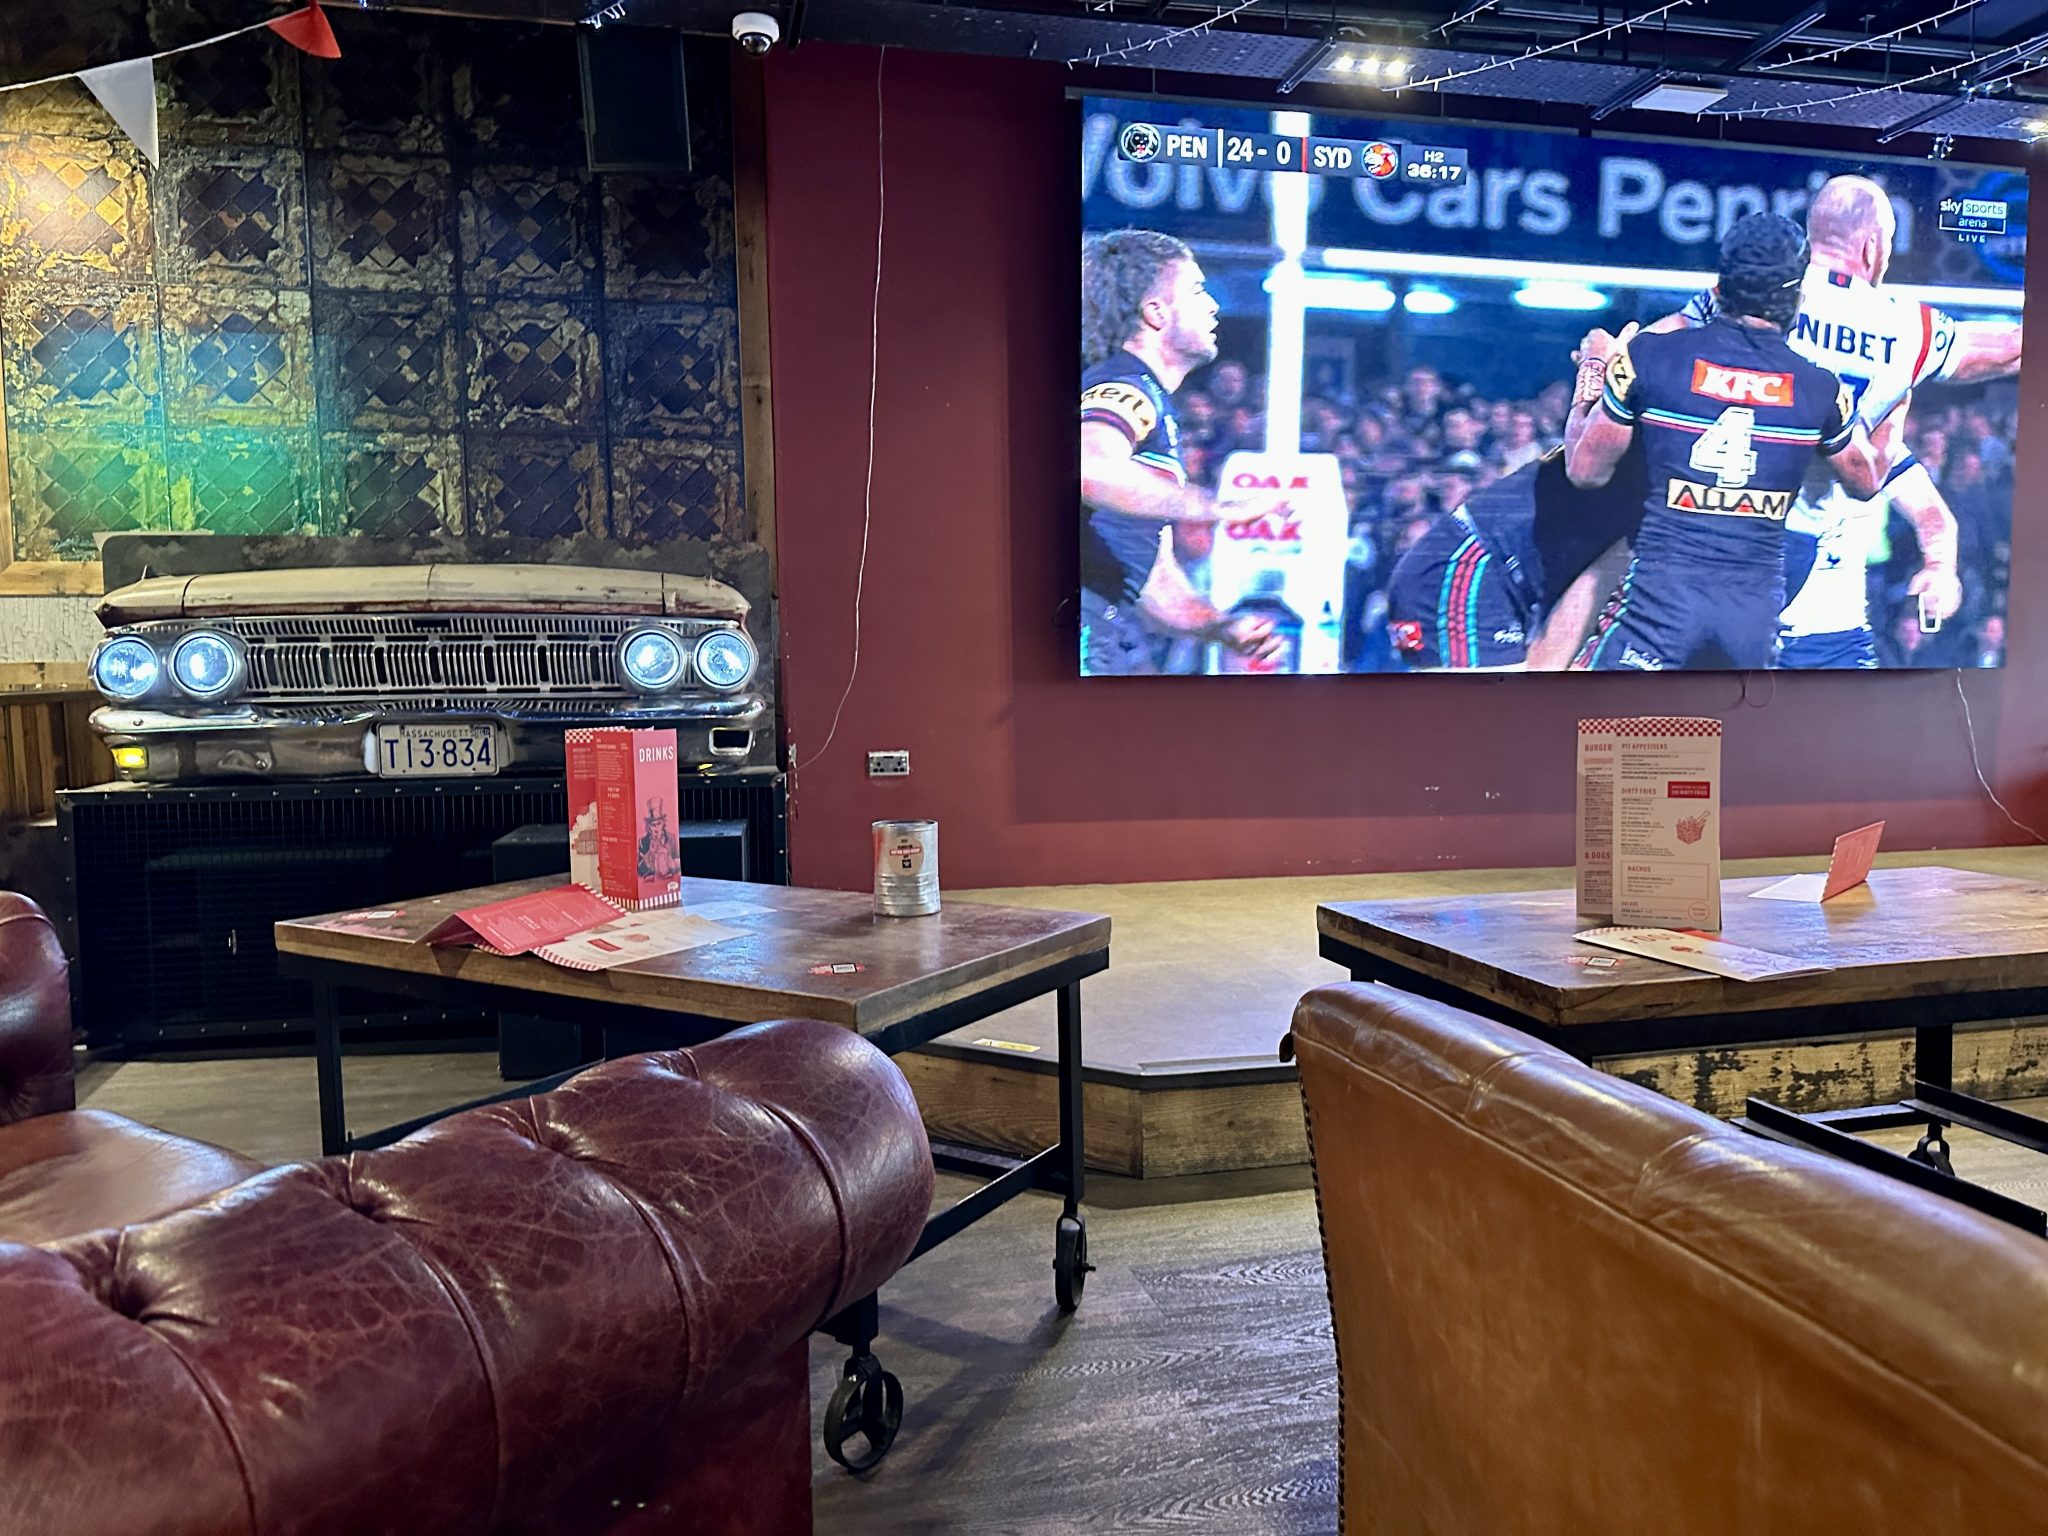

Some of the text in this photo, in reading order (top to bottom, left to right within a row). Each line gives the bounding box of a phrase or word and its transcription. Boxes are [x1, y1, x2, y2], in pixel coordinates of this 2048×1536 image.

[1166, 134, 1208, 159] PEN
[1226, 137, 1254, 162] 24
[1276, 140, 1291, 165] 0
[1313, 145, 1352, 169] SYD
[1424, 150, 1445, 163] H2
[1940, 198, 2004, 215] sky sports
[1958, 217, 1988, 228] arena
[1958, 233, 1986, 243] LIVE
[1698, 366, 1784, 403] KFC
[1689, 405, 1758, 488] 4
[639, 745, 675, 763] DRINKS
